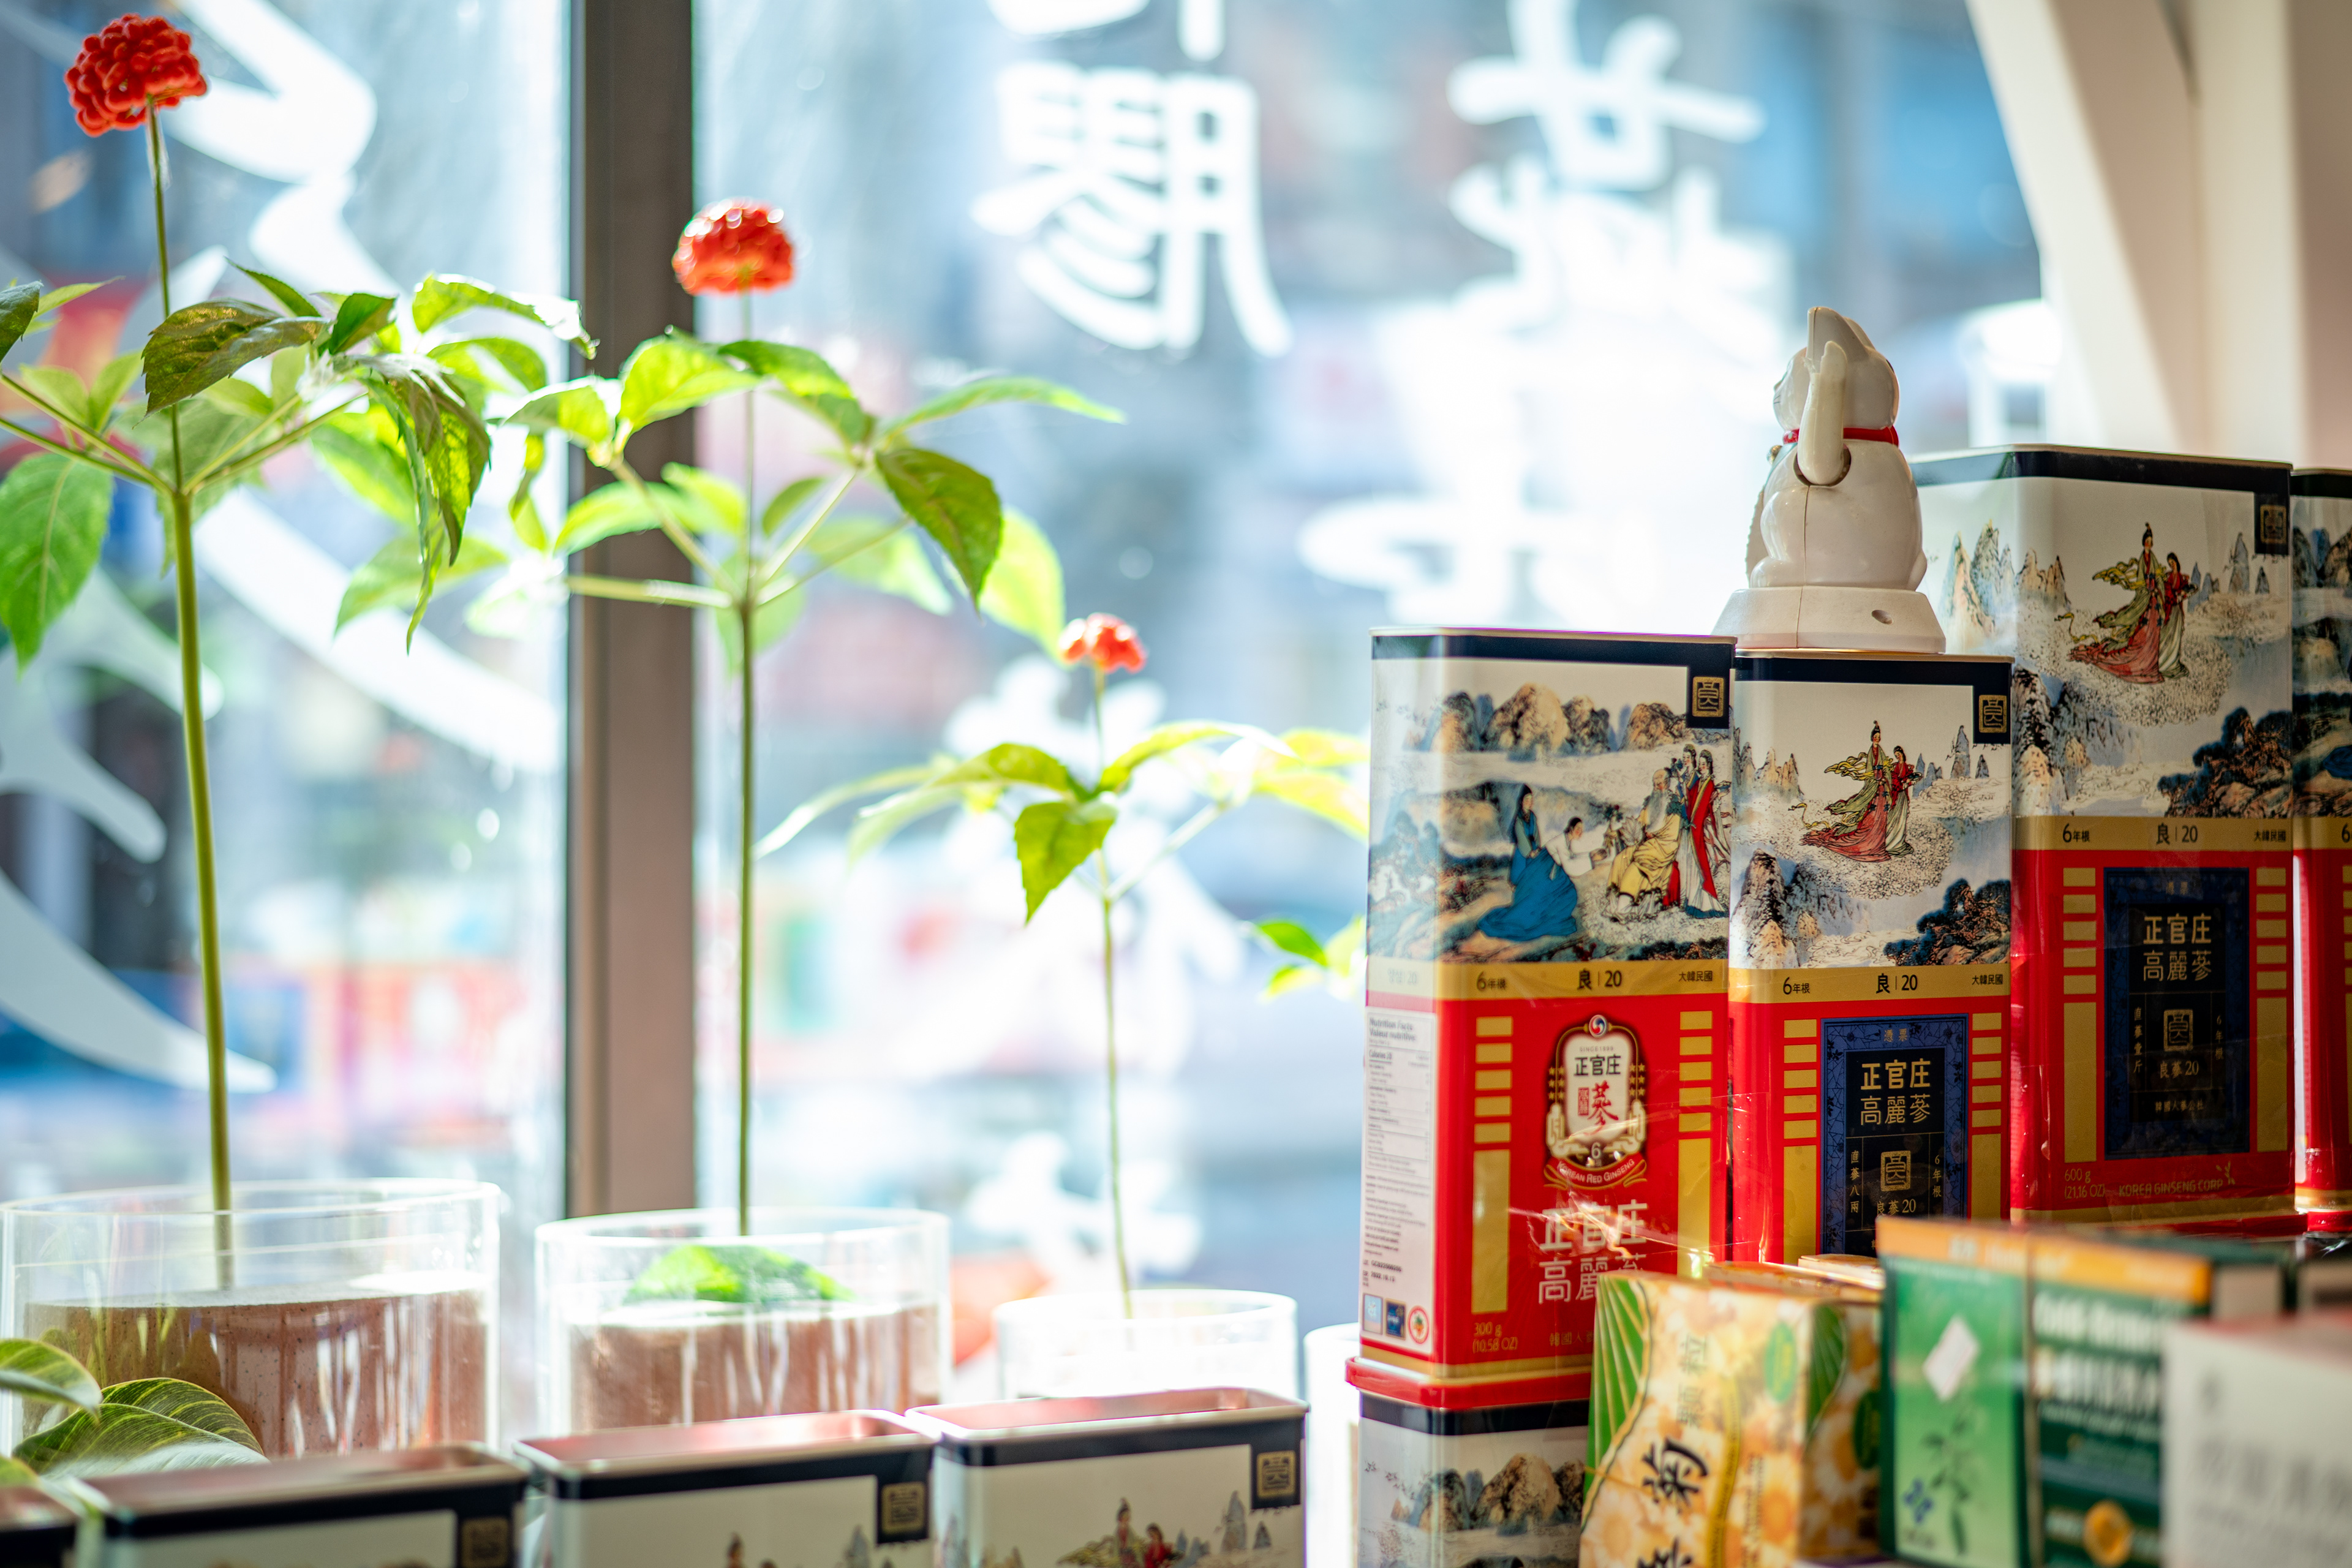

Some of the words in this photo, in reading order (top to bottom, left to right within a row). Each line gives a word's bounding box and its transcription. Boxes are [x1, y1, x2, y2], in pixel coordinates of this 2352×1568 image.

[2062, 823, 2090, 843] 6年根
[2156, 822, 2170, 845] 良
[2182, 825, 2198, 843] 20
[2342, 823, 2352, 843] 6
[2143, 913, 2212, 944] 正官庄
[1577, 968, 1592, 990] 良
[1605, 970, 1622, 987] 20
[1678, 970, 1713, 982] 大韓民國
[1783, 976, 1810, 995] 6年根
[1876, 973, 1890, 993] 良
[1901, 974, 1918, 990] 20
[1972, 974, 2003, 985] 大韓民國
[1370, 1017, 1396, 1028] Nutrition
[1398, 1020, 1412, 1030] Facts
[1370, 1028, 1387, 1038] Valeur
[1389, 1032, 1416, 1041] nutritive
[1370, 1049, 1385, 1058] Calories
[1574, 1054, 1621, 1076] 正官庄
[1860, 1058, 1931, 1090] 正官庄
[1860, 1093, 1931, 1126] 高麗蔘
[1591, 1142, 1601, 1159] 6
[1586, 1174, 1602, 1184] RED
[1604, 1159, 1635, 1182] GINSENG
[1932, 1155, 1942, 1197] 6年根
[2064, 1168, 2082, 1182] 600
[2084, 1170, 2091, 1184] g
[2089, 1184, 2105, 1197] OZ)
[2119, 1183, 2152, 1197] KOREA
[2154, 1180, 2196, 1195] GINSENG
[1539, 1199, 1648, 1251] 正官庄
[1474, 1321, 1493, 1337] 300
[1494, 1324, 1502, 1338] g
[1472, 1337, 1499, 1354] (10.58
[1501, 1336, 1518, 1350] OZ)
